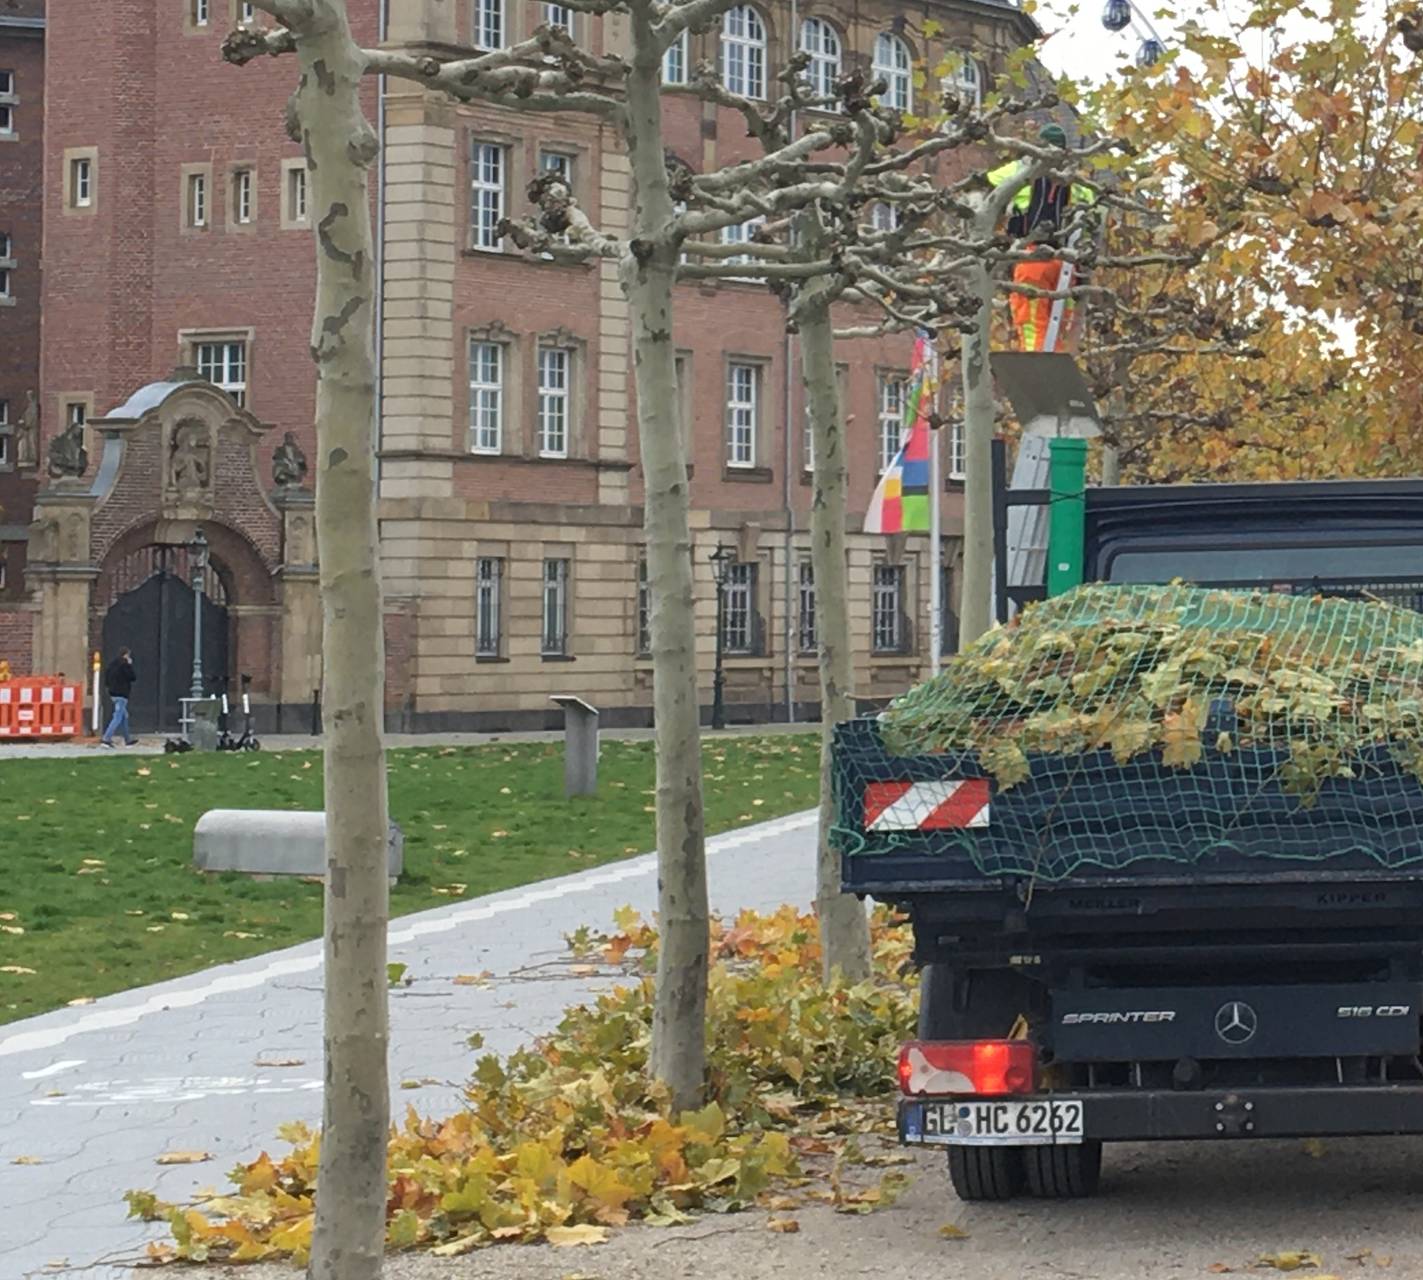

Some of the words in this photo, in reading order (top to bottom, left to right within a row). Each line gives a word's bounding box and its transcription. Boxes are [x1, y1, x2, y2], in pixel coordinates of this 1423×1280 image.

[1061, 1010, 1176, 1025] SPRINTER
[1375, 1004, 1410, 1017] CDI
[976, 1104, 1009, 1135] HC
[1015, 1103, 1081, 1134] 6262
